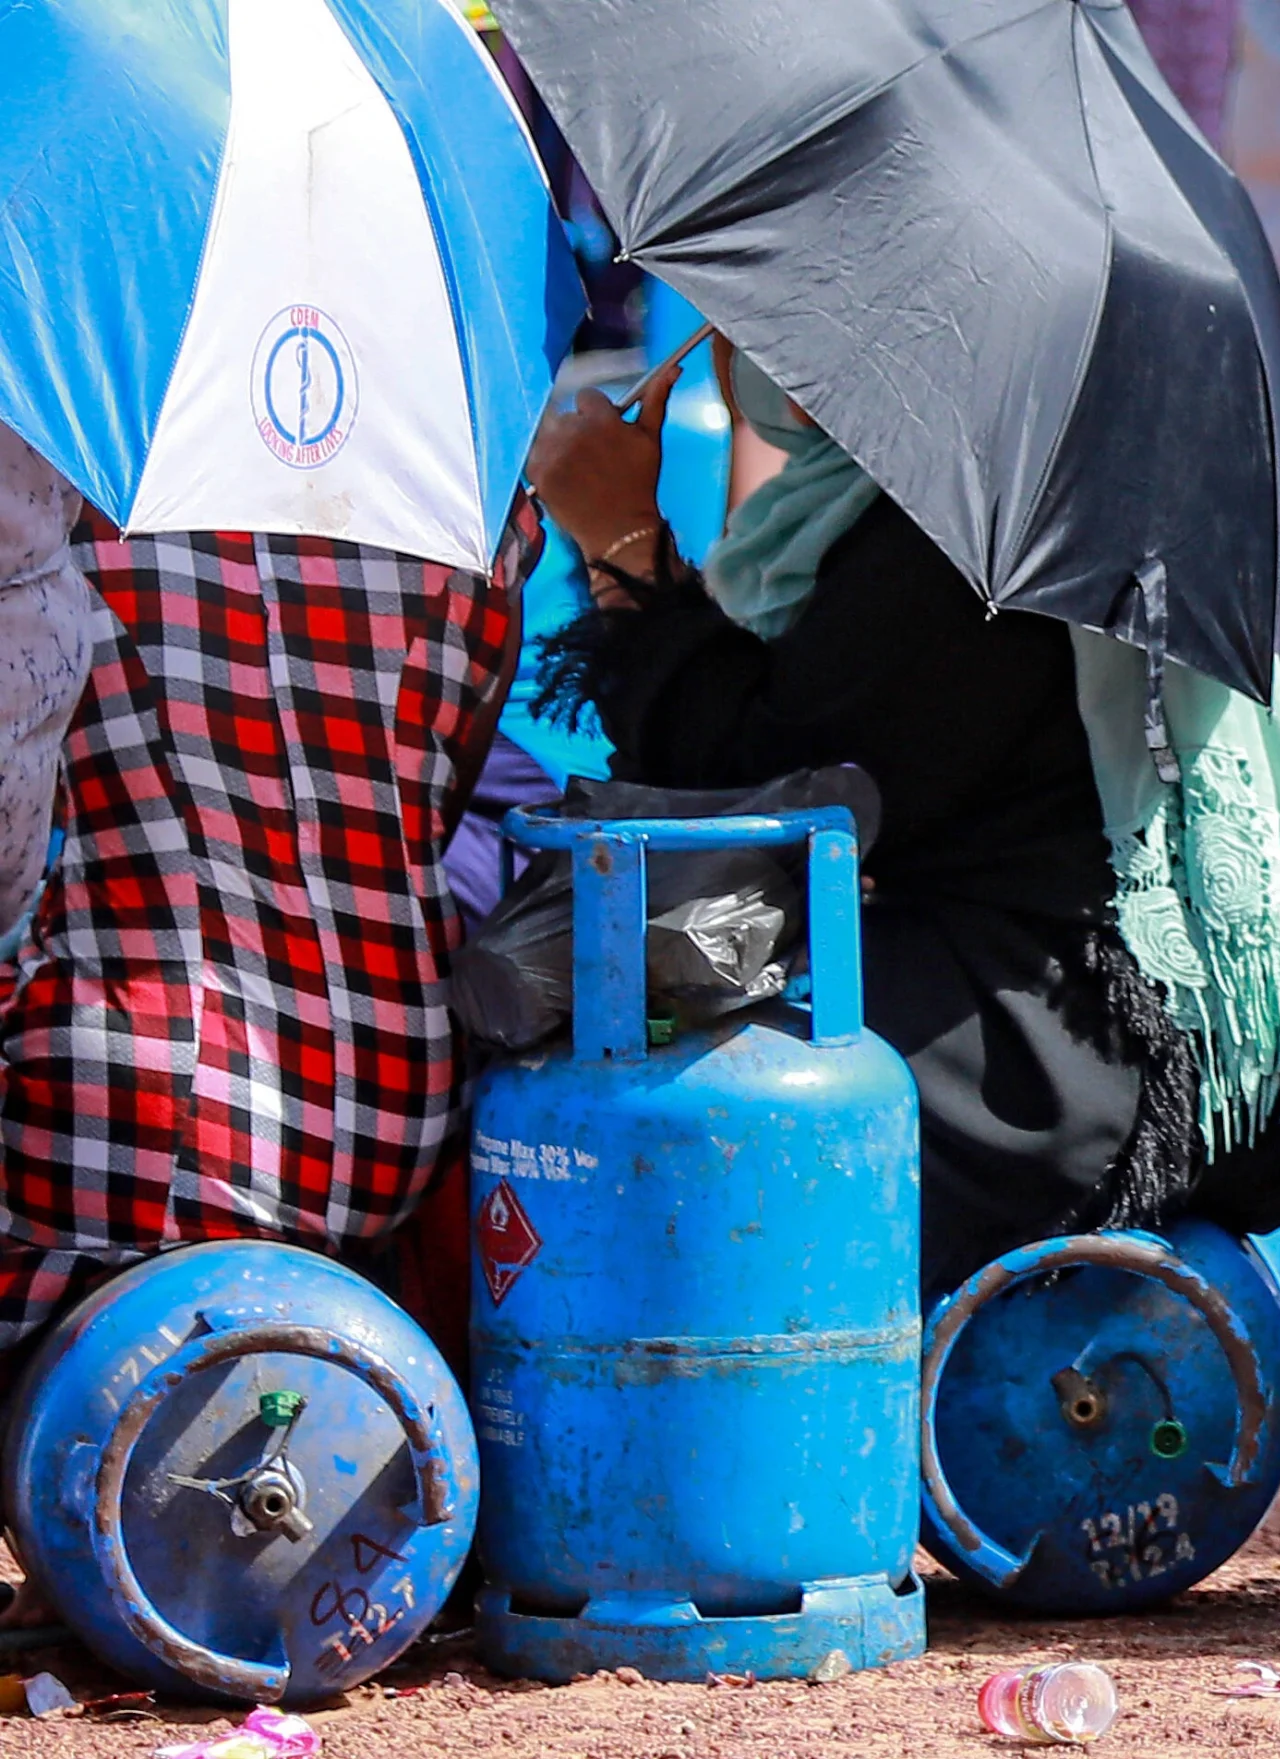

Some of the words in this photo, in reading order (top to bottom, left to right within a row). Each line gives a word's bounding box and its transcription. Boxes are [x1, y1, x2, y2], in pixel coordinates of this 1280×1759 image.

[259, 416, 294, 462] LOOKING
[294, 444, 321, 464] AFTER
[320, 423, 344, 458] LIVES
